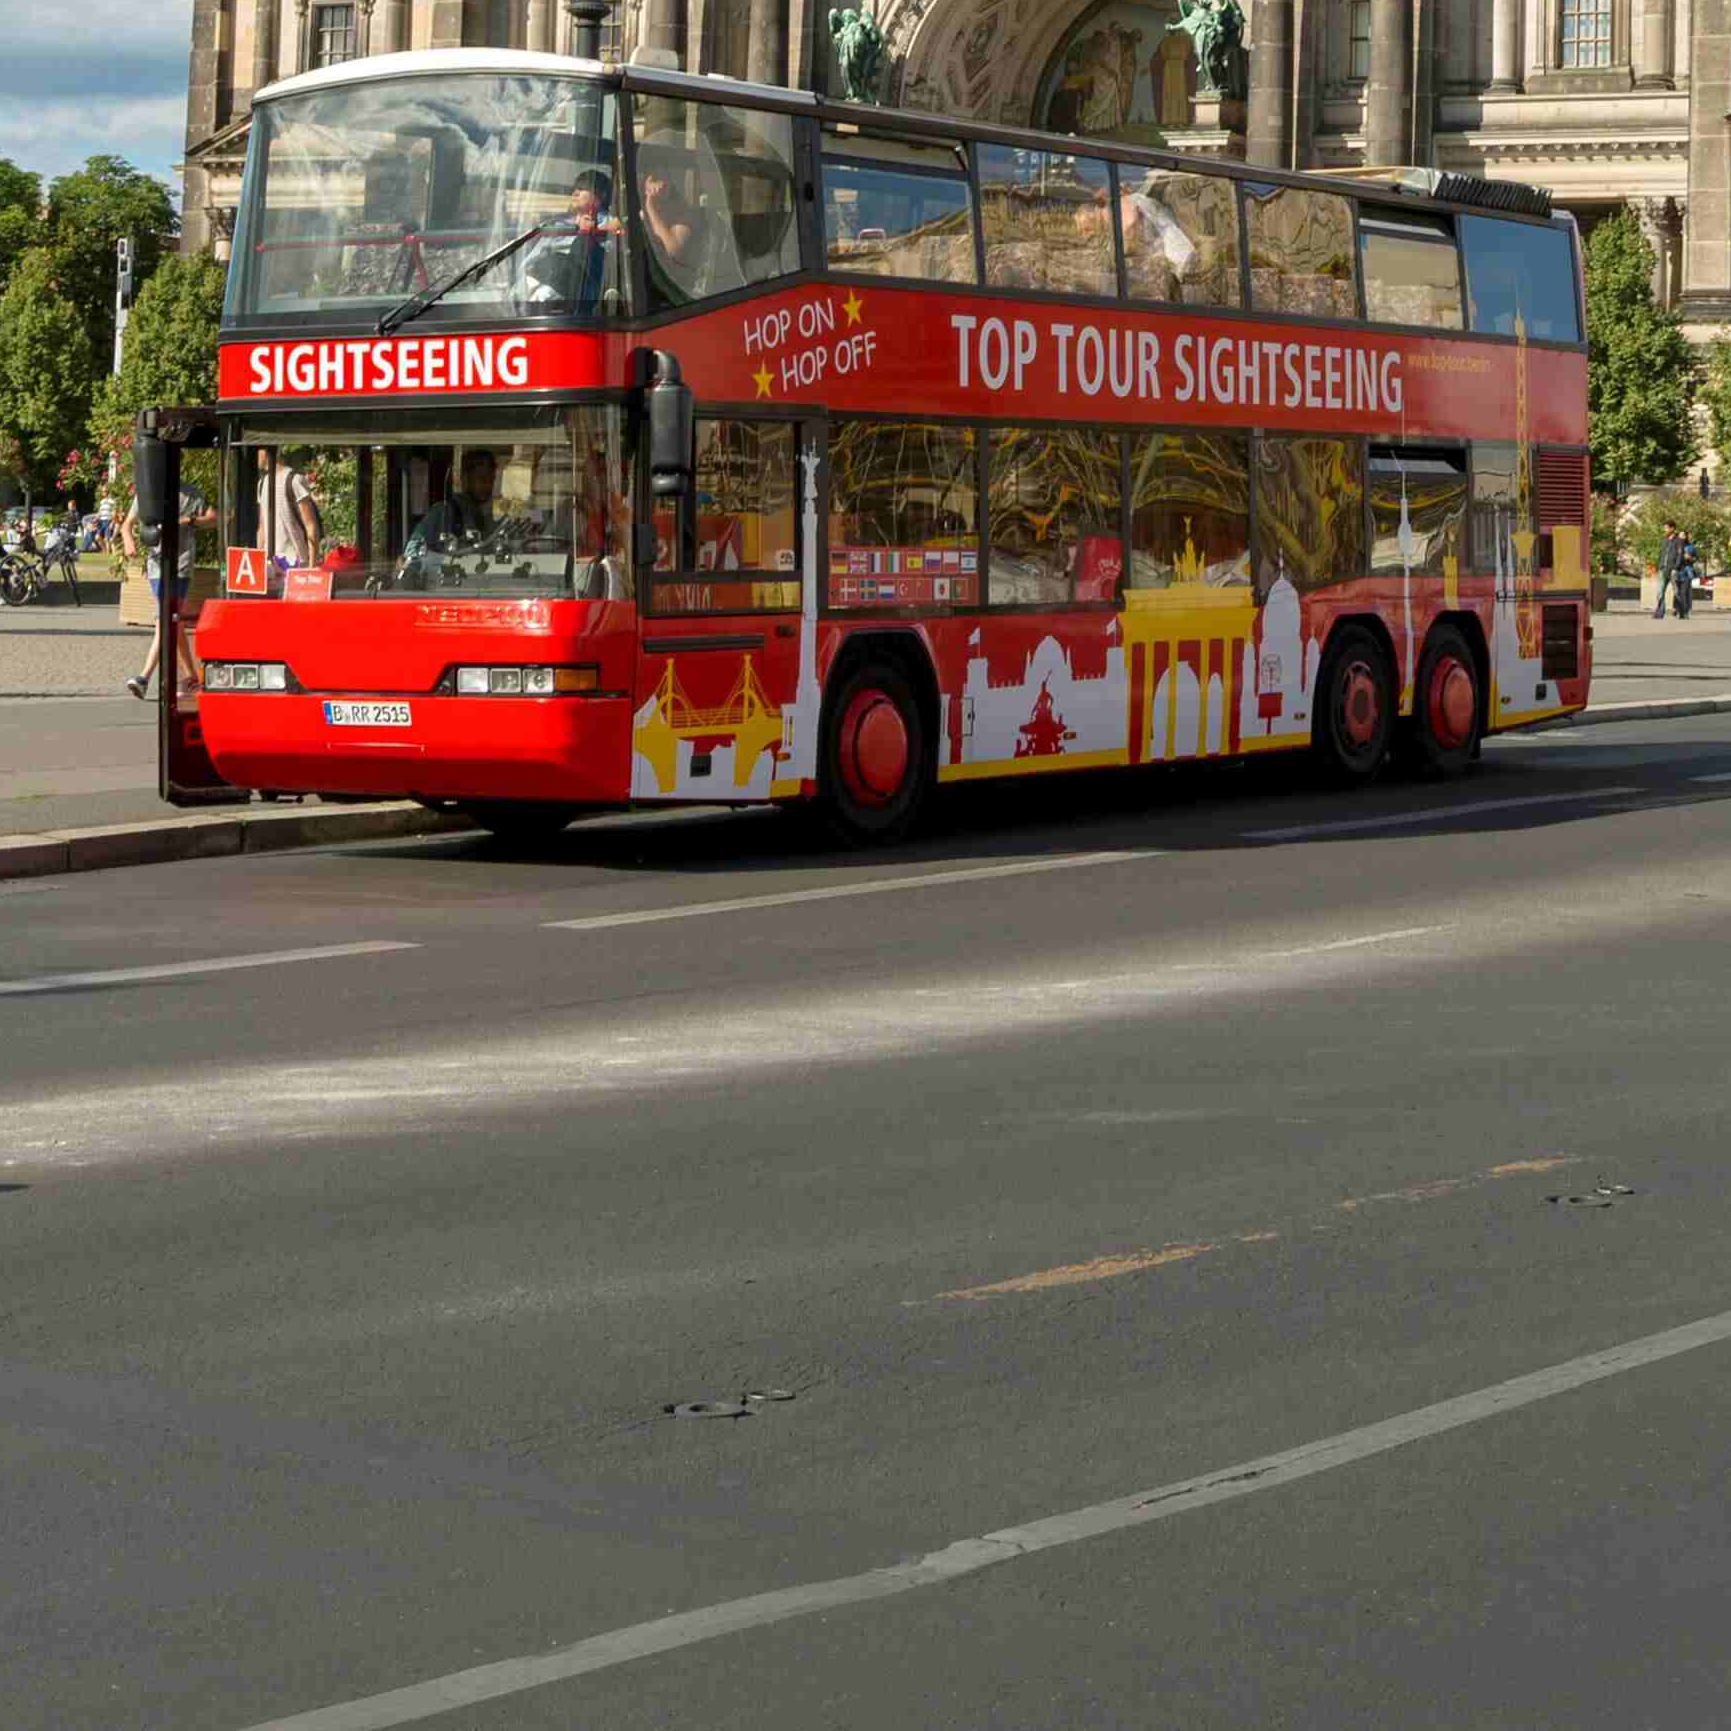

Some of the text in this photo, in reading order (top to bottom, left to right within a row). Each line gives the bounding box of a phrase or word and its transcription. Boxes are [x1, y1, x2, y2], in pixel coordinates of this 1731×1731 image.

[744, 297, 835, 356] HOP ON
[249, 336, 528, 393] SIGHTSEEING
[780, 330, 877, 392] HOP OFF
[950, 314, 1404, 414] TOP TOUR SIGHTSEEING
[235, 551, 256, 586] A
[332, 705, 410, 723] B RR 2515
